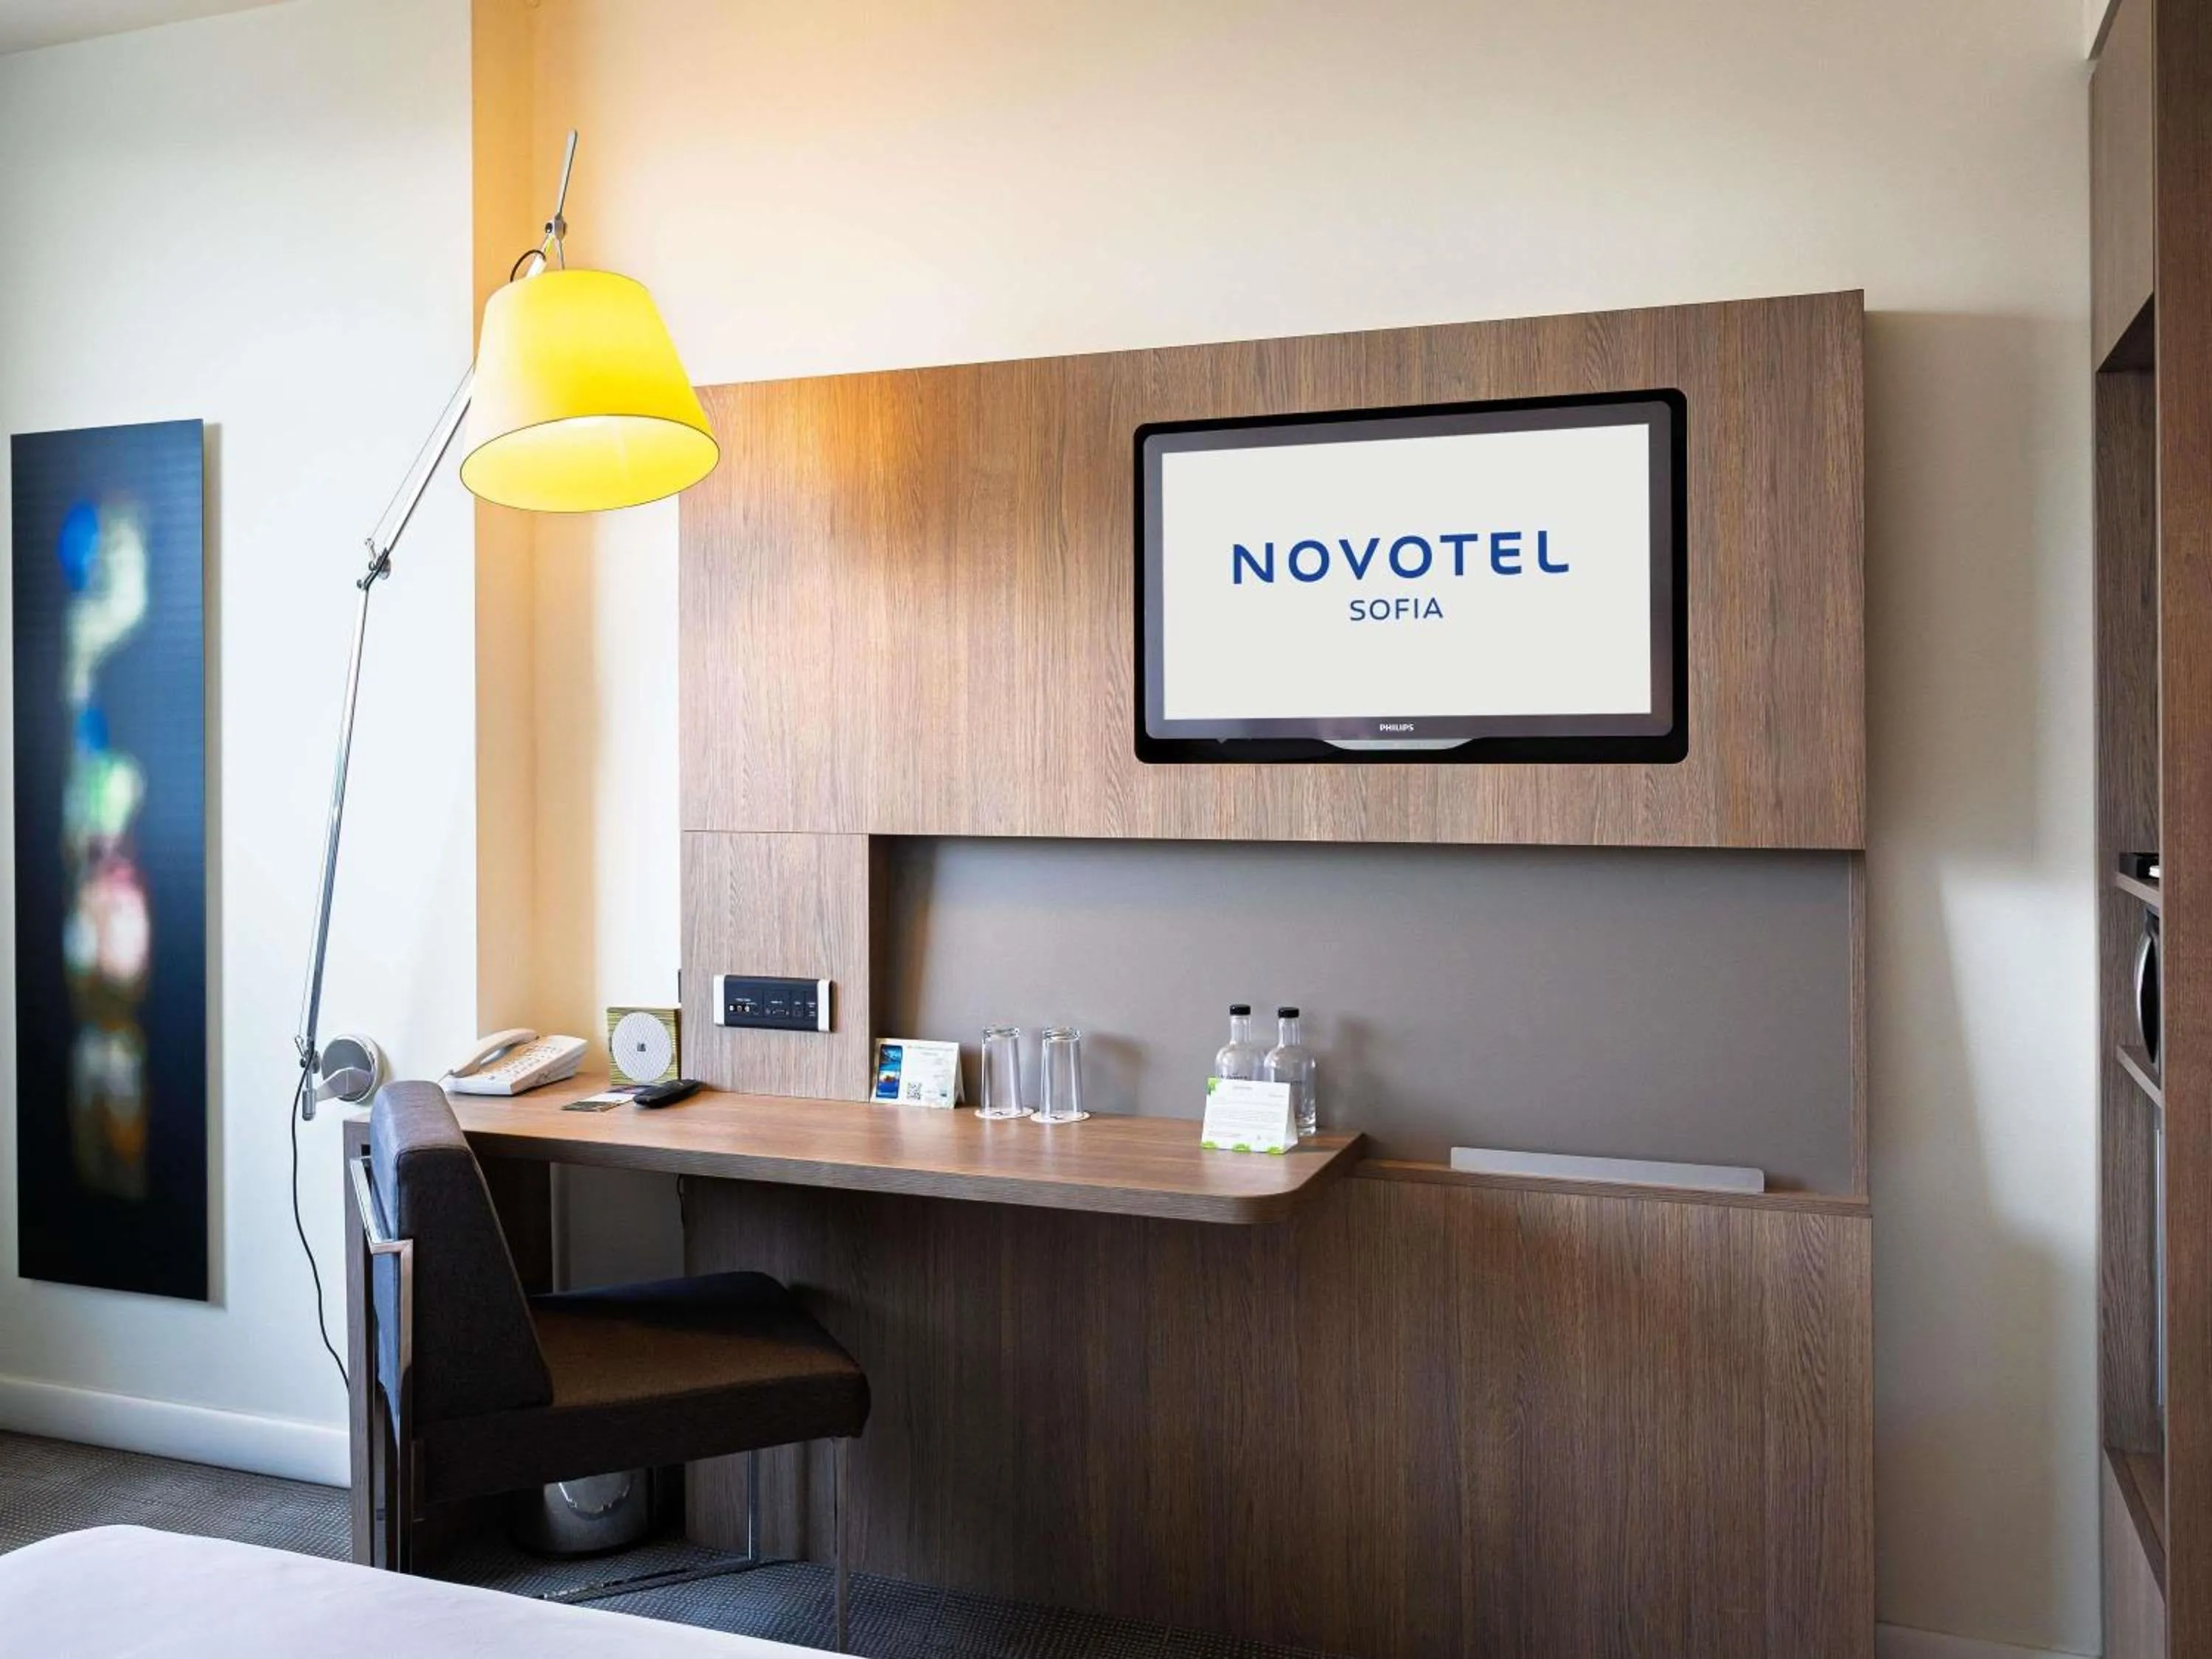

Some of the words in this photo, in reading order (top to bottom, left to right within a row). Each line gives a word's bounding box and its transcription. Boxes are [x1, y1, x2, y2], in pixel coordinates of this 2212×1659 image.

[1232, 530, 1570, 585] NOVOTEL
[1349, 597, 1444, 622] SOFIA
[1380, 723, 1415, 732] PHILIPS
